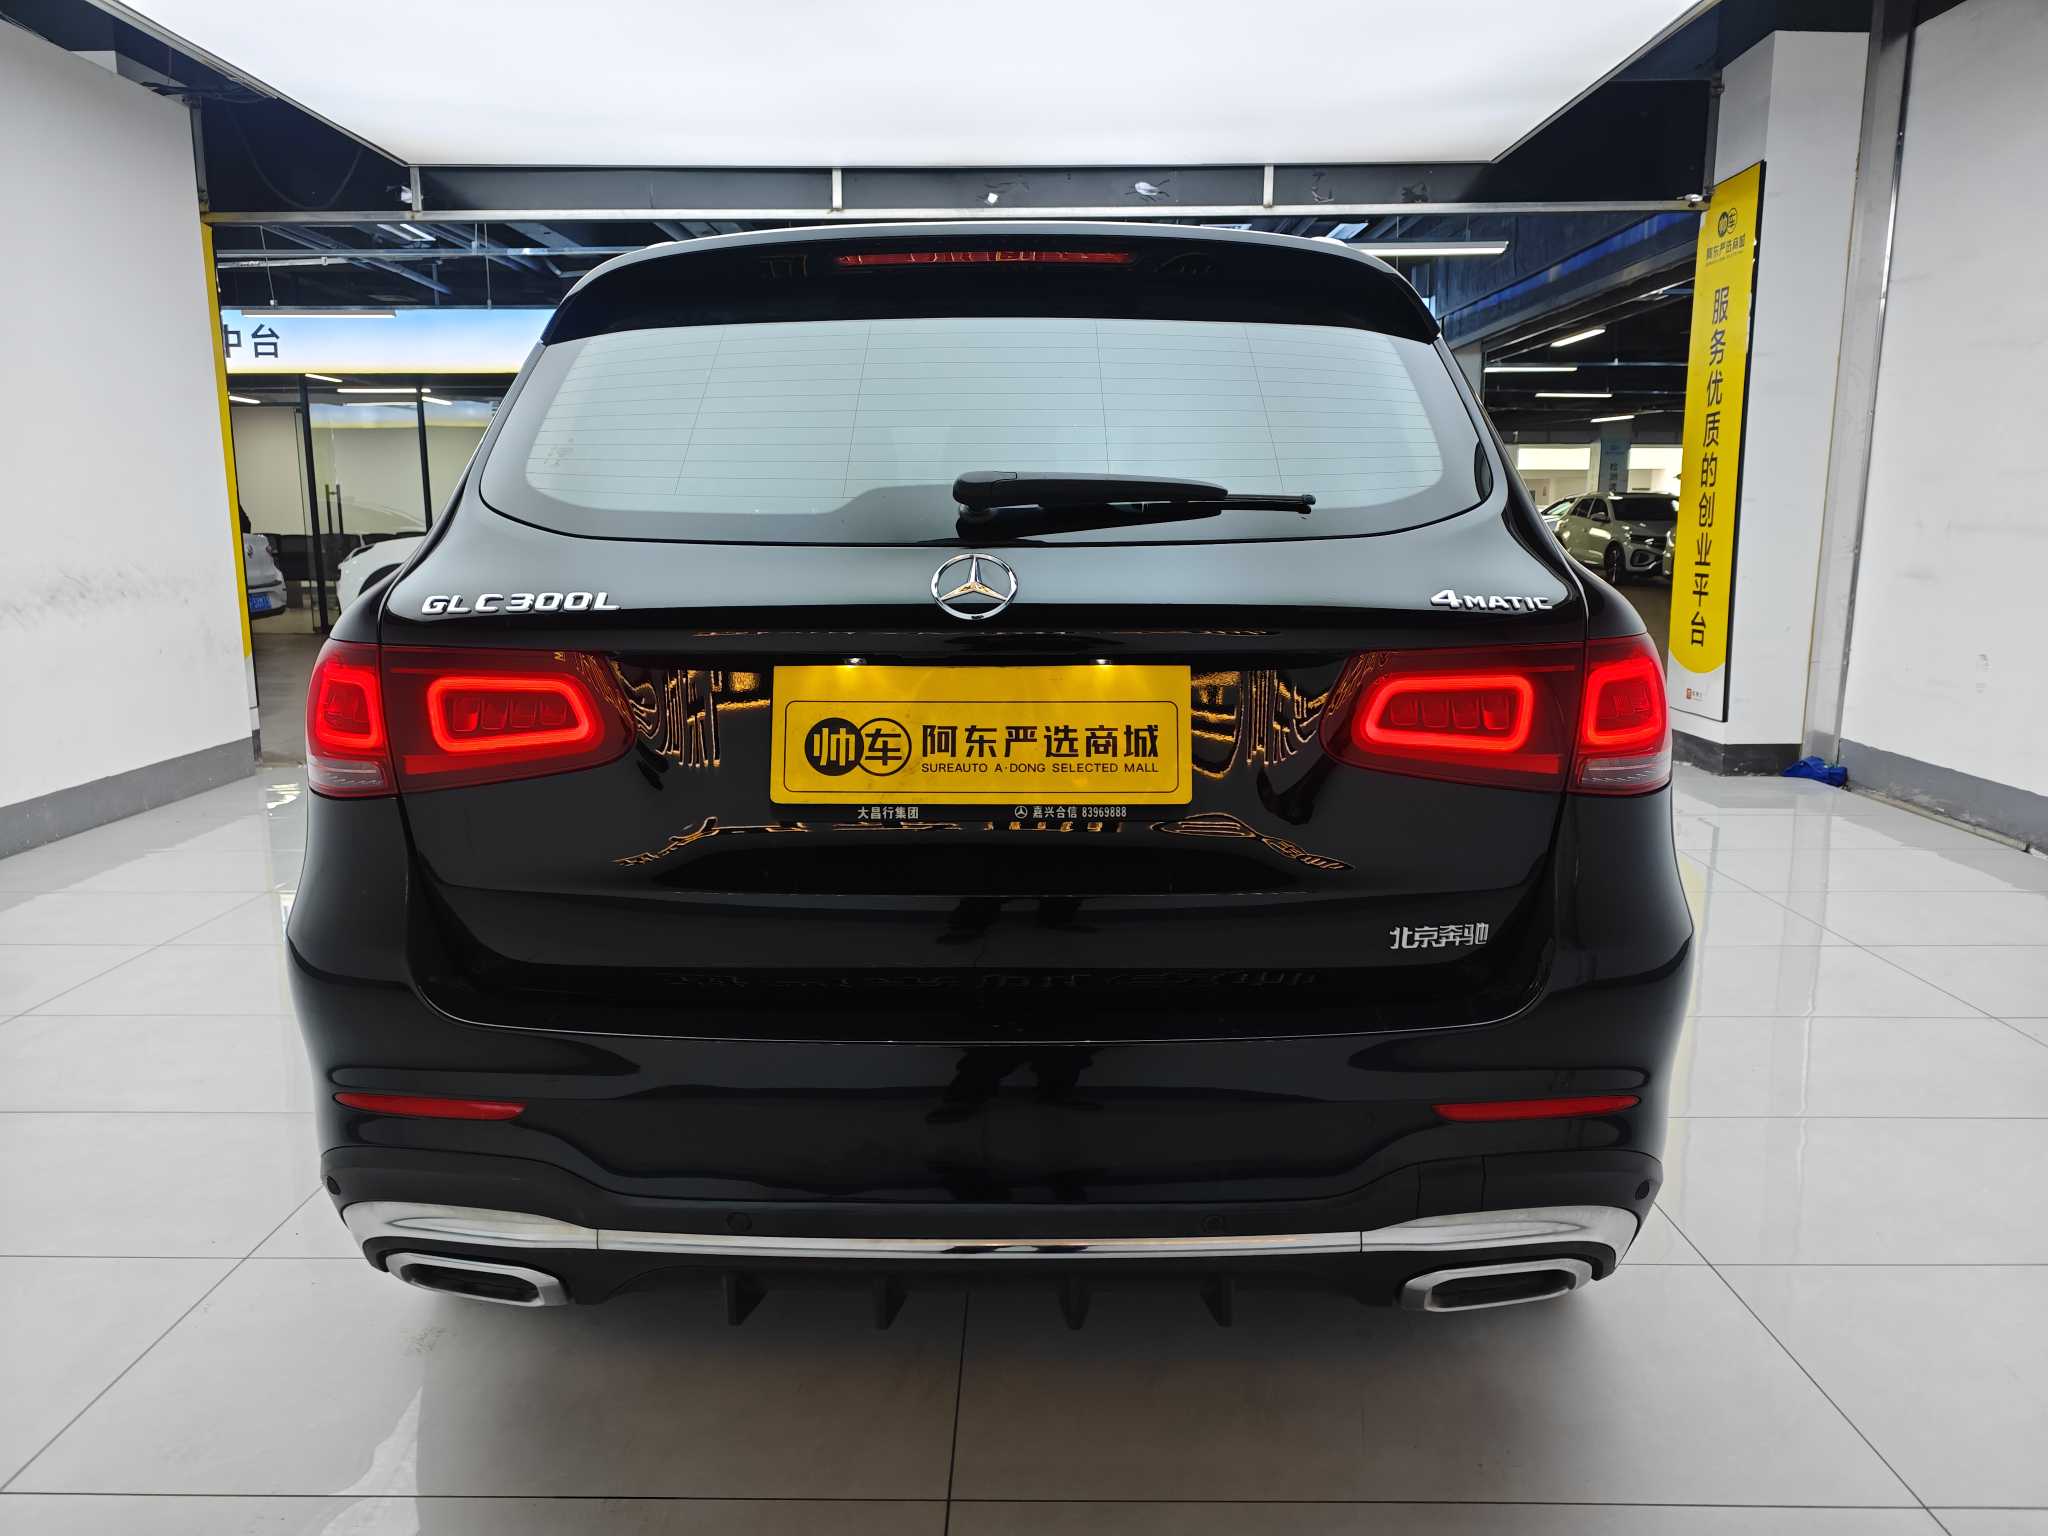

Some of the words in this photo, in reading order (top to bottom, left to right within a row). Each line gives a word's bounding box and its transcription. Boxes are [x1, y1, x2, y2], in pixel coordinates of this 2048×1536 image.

[1690, 286, 1730, 648] 服务优质的创业平台
[1430, 589, 1553, 610] 4MATIC
[922, 724, 1160, 758] 阿东严选商城
[921, 762, 988, 773] SUREAUTO
[1052, 762, 1119, 773] SELECTED
[1124, 762, 1160, 773] MALL
[857, 805, 920, 820] 大昌行集团
[1032, 805, 1078, 819] 嘉兴合信
[1081, 806, 1128, 819] 83969888
[1389, 921, 1490, 950] 北京奔驰
